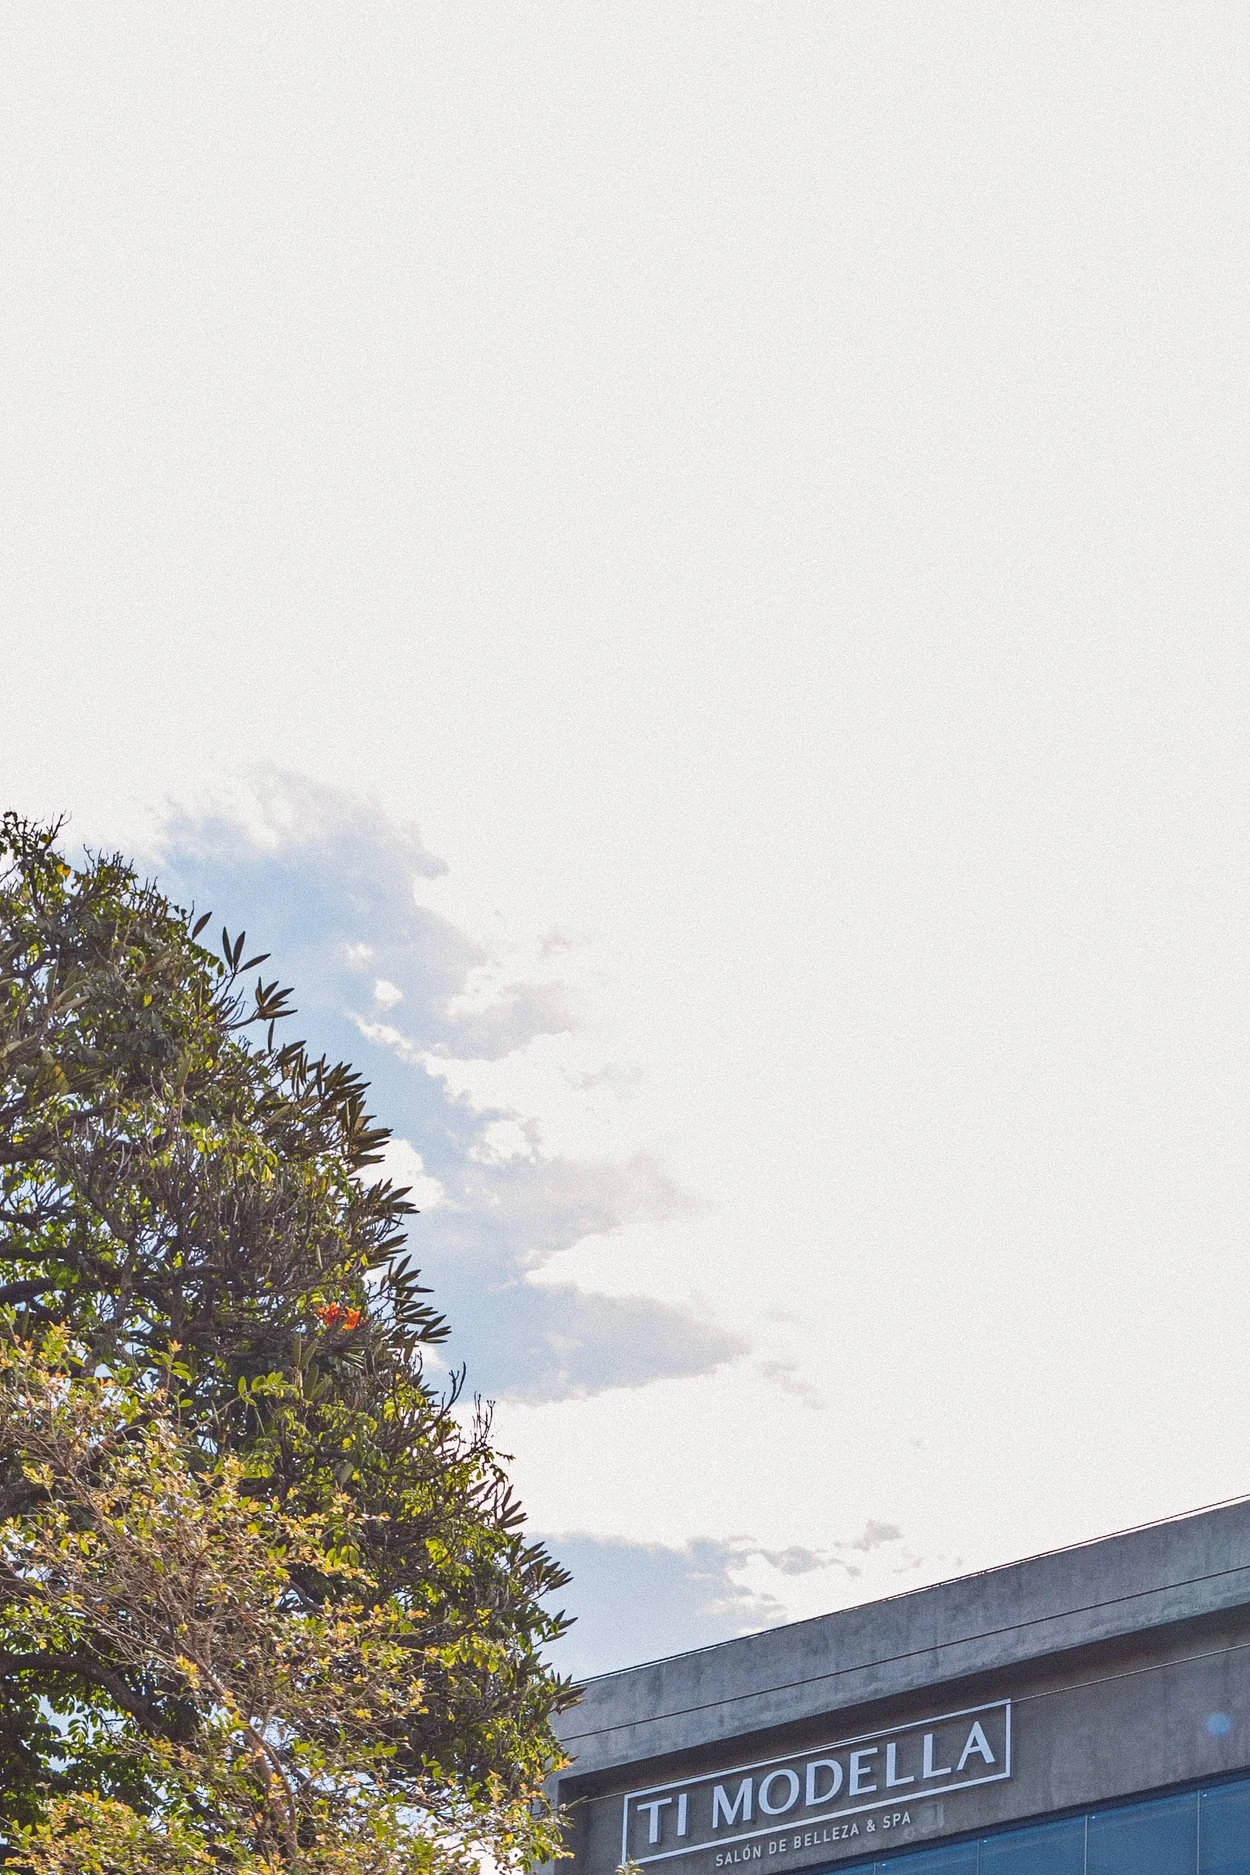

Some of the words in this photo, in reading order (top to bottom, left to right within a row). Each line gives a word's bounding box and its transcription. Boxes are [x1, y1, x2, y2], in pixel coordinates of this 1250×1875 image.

[637, 1795, 687, 1844] TI
[712, 1721, 995, 1828] MODELLA
[715, 1846, 761, 1867] SALÓN
[769, 1841, 787, 1854] DE
[794, 1824, 859, 1849] BELLEZA
[867, 1819, 876, 1832] &
[883, 1811, 910, 1827] SPA
